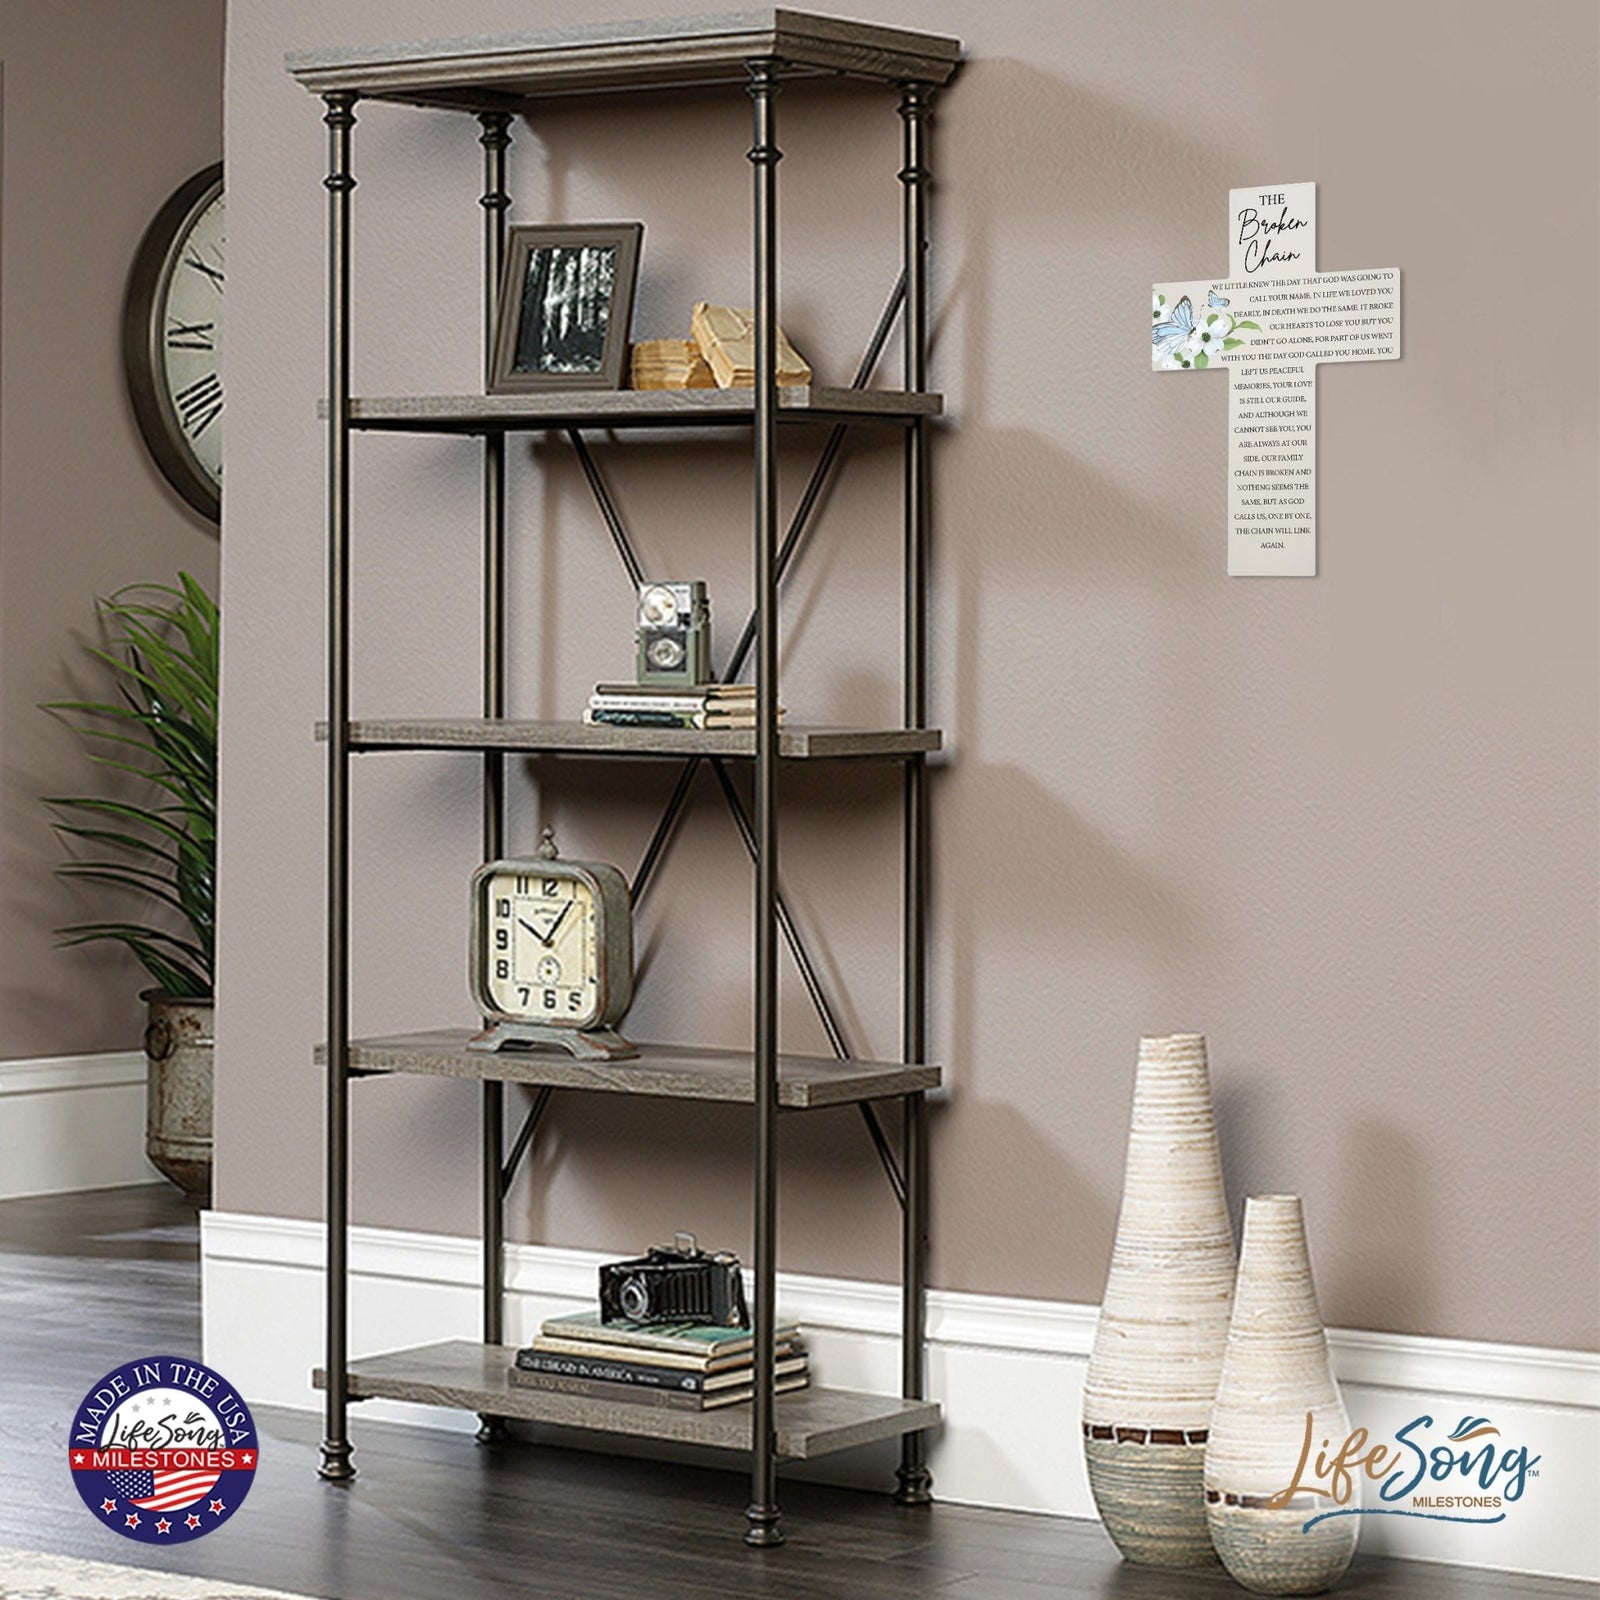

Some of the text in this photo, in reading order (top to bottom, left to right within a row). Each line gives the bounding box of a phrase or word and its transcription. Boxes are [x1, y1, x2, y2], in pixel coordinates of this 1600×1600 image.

[1259, 193, 1286, 206] THE
[1238, 207, 1309, 245] Broken
[1244, 239, 1301, 273] Chain
[1212, 283, 1224, 291] WE
[1225, 282, 1248, 290] LITTLE
[1303, 276, 1323, 285] THAT
[1323, 276, 1339, 284] GOD
[1357, 273, 1383, 281] GOING
[1383, 272, 1394, 280] TO
[1250, 295, 1268, 303] CALL
[1268, 294, 1288, 302] YOUR
[1352, 288, 1376, 297] LOVED
[1377, 287, 1394, 295] YOU
[1272, 308, 1296, 316] DEATH
[1361, 303, 1369, 311] IT
[1370, 302, 1394, 310] BROKE
[1269, 323, 1285, 331] OUR
[1286, 322, 1313, 330] HEARTS
[1276, 337, 1288, 345] GO
[1315, 335, 1330, 343] FOR
[1331, 334, 1348, 342] PART
[1371, 332, 1394, 340] WENT
[1221, 354, 1241, 362] WITH
[1241, 353, 1257, 361] YOU
[1273, 352, 1288, 360] DAY
[1288, 351, 1305, 359] GOD
[1306, 350, 1334, 358] CALLED
[1335, 349, 1351, 357] YOU
[1241, 368, 1258, 376] LEFT
[1269, 366, 1305, 375] PEACEFUL
[1234, 382, 1272, 391] MEMORIES,
[1273, 381, 1293, 389] YOUR
[1255, 410, 1295, 418] ALTHOUGH
[1234, 426, 1265, 434] CANNOT
[1279, 425, 1296, 433] YOU,
[1297, 424, 1312, 432] YOU
[1253, 440, 1281, 448] ALWAYS
[1261, 454, 1279, 462] OUR
[1279, 454, 1304, 462] FAMILY
[1295, 468, 1312, 476] AND
[1271, 483, 1294, 491] SEEMS
[1263, 498, 1277, 506] BUT
[1285, 512, 1294, 520] BY
[1251, 527, 1274, 535] CHAIN
[517, 875, 529, 894] 11
[542, 878, 559, 897] 12
[496, 899, 510, 918] 10
[496, 929, 509, 951] 9
[496, 959, 509, 979] 8
[518, 987, 582, 1012] 7 6 5
